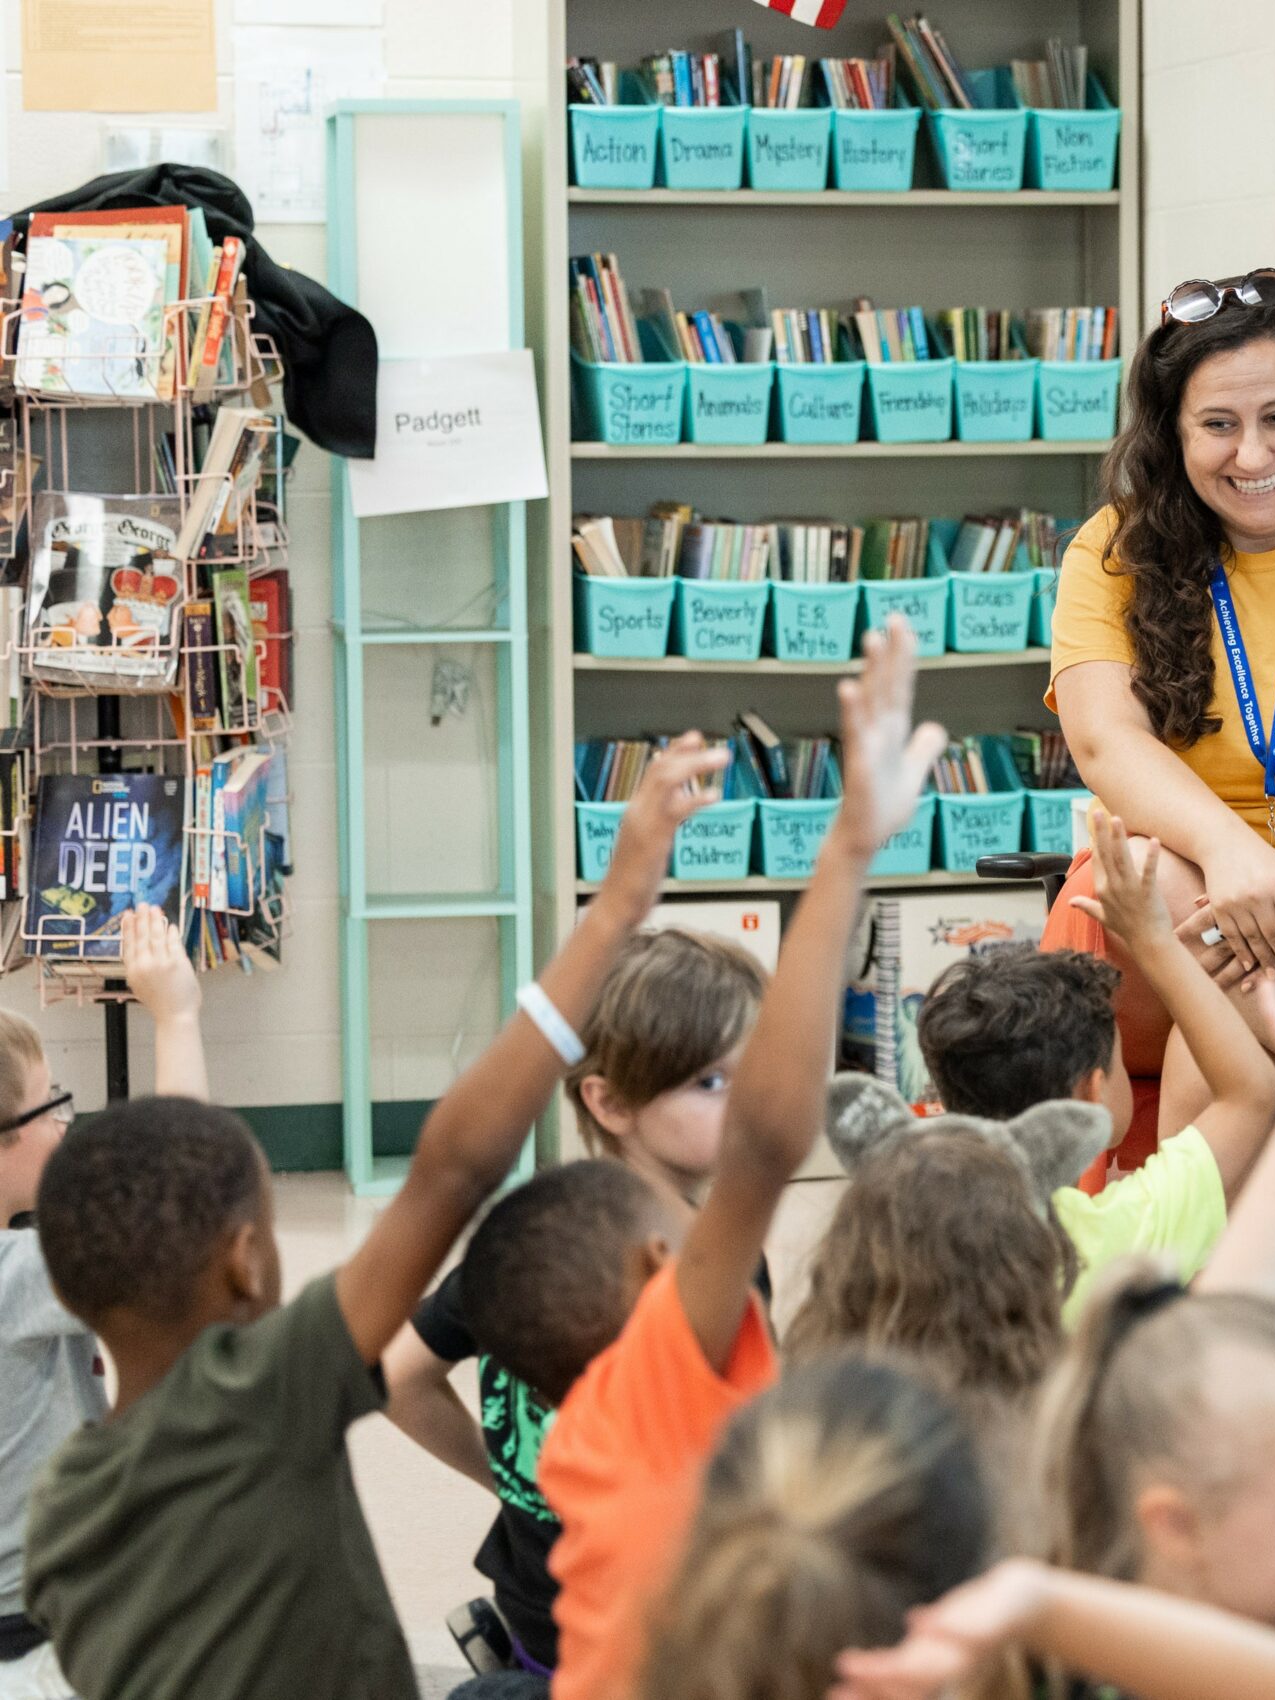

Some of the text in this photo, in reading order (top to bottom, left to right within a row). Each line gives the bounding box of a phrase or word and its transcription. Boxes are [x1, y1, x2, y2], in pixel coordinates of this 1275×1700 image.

[583, 133, 647, 164] Action
[671, 137, 733, 163] Drama
[755, 134, 823, 168] Mystery
[954, 128, 1009, 156] Short
[1056, 127, 1093, 149] Non
[842, 138, 906, 170] History
[1045, 154, 1107, 177] Fiction
[953, 162, 1013, 182] Stories
[609, 381, 674, 412] Short
[697, 391, 763, 418] Animals
[788, 391, 856, 420] Culture
[1046, 387, 1109, 416] School
[395, 408, 481, 434] Padgett
[609, 412, 675, 442] Stories
[118, 518, 171, 551] George
[598, 604, 664, 637] Sports
[691, 599, 758, 625] Beverly
[960, 614, 1022, 640] Sachar
[695, 629, 753, 655] Cleary
[784, 628, 840, 658] White
[1218, 598, 1260, 746] Achieving Excellence Together
[65, 802, 149, 839] ALIEN
[682, 818, 741, 839] Boxcar
[951, 808, 1012, 833] Magic
[58, 841, 157, 893] DEEP
[679, 846, 743, 867] Children
